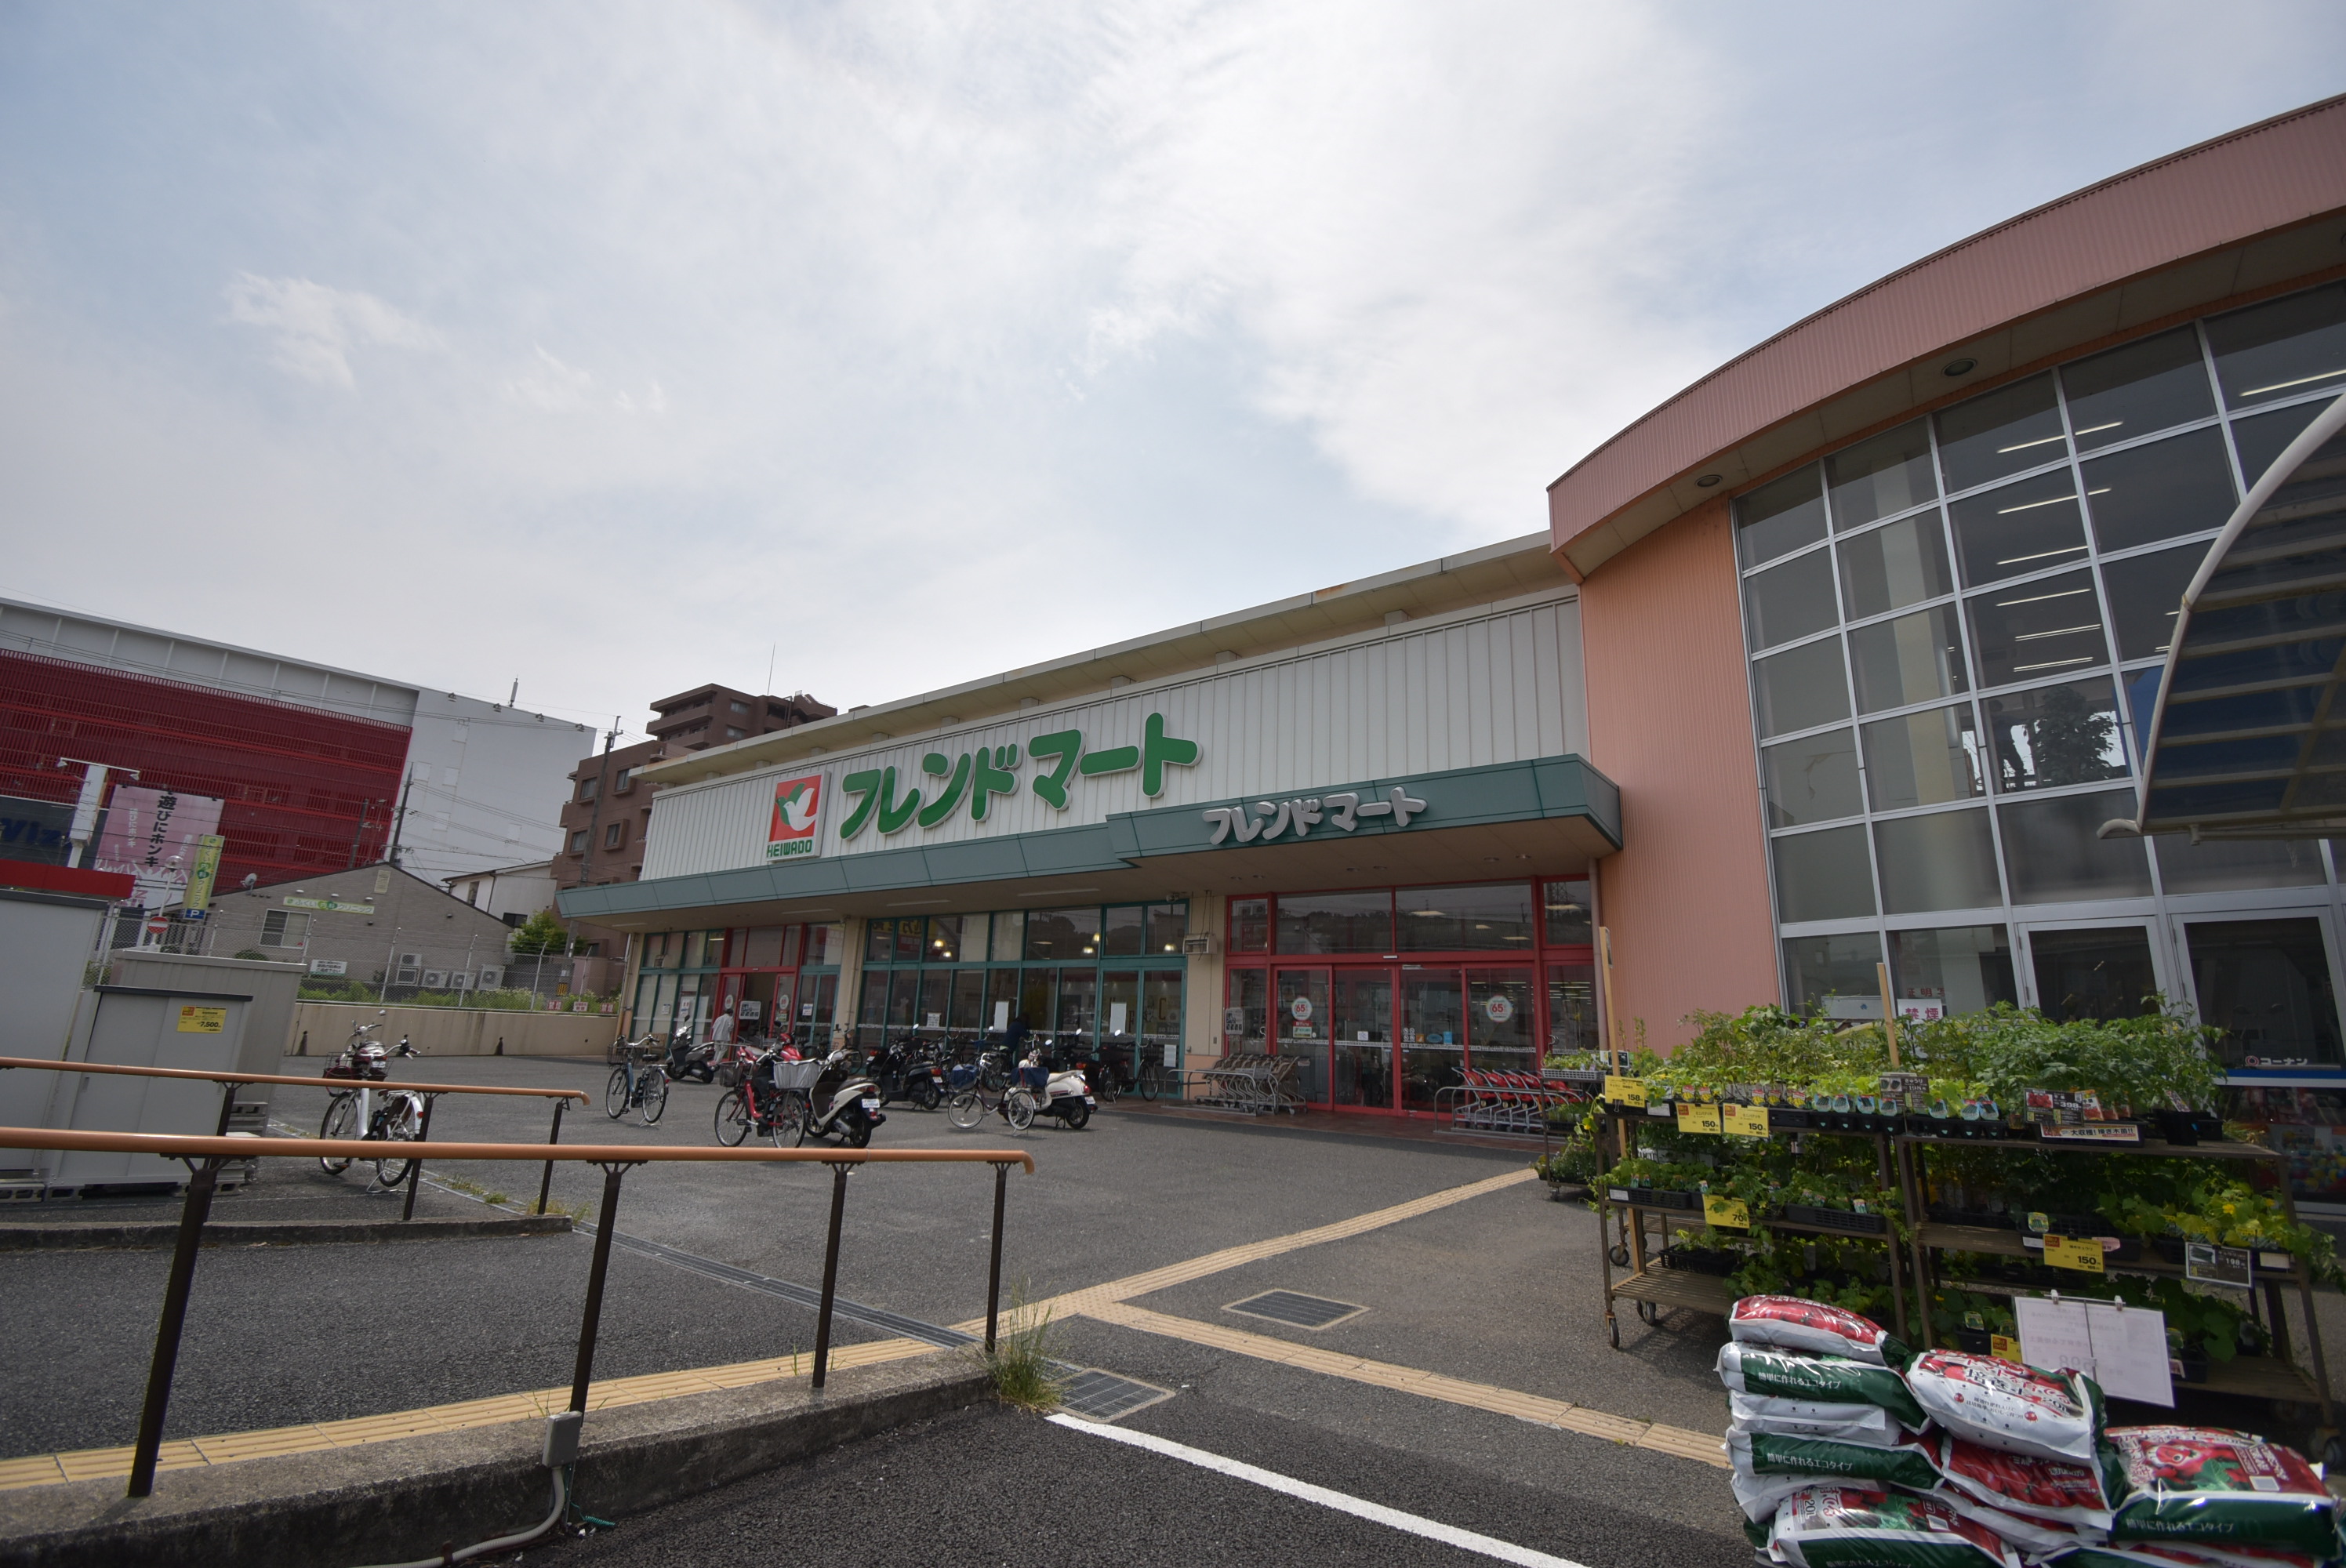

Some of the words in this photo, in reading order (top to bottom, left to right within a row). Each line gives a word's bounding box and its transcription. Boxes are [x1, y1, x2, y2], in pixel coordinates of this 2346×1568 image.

[840, 712, 1202, 840] フレンドマート
[1203, 786, 1427, 845] フレンドマート
[144, 795, 178, 867] 遊びにホンキ
[766, 838, 813, 858] HEIWADO
[1296, 1004, 1306, 1013] 65
[1491, 1004, 1504, 1013] 65
[2260, 1057, 2308, 1066] コーナン
[2077, 1256, 2097, 1265] 150
[1758, 1371, 1842, 1389] 簡単に作れるエコタイプ
[1767, 1452, 1853, 1471] 簡単に作れるエコタイプ
[2126, 1518, 2235, 1534] 簡単に作れるエコタイプ
